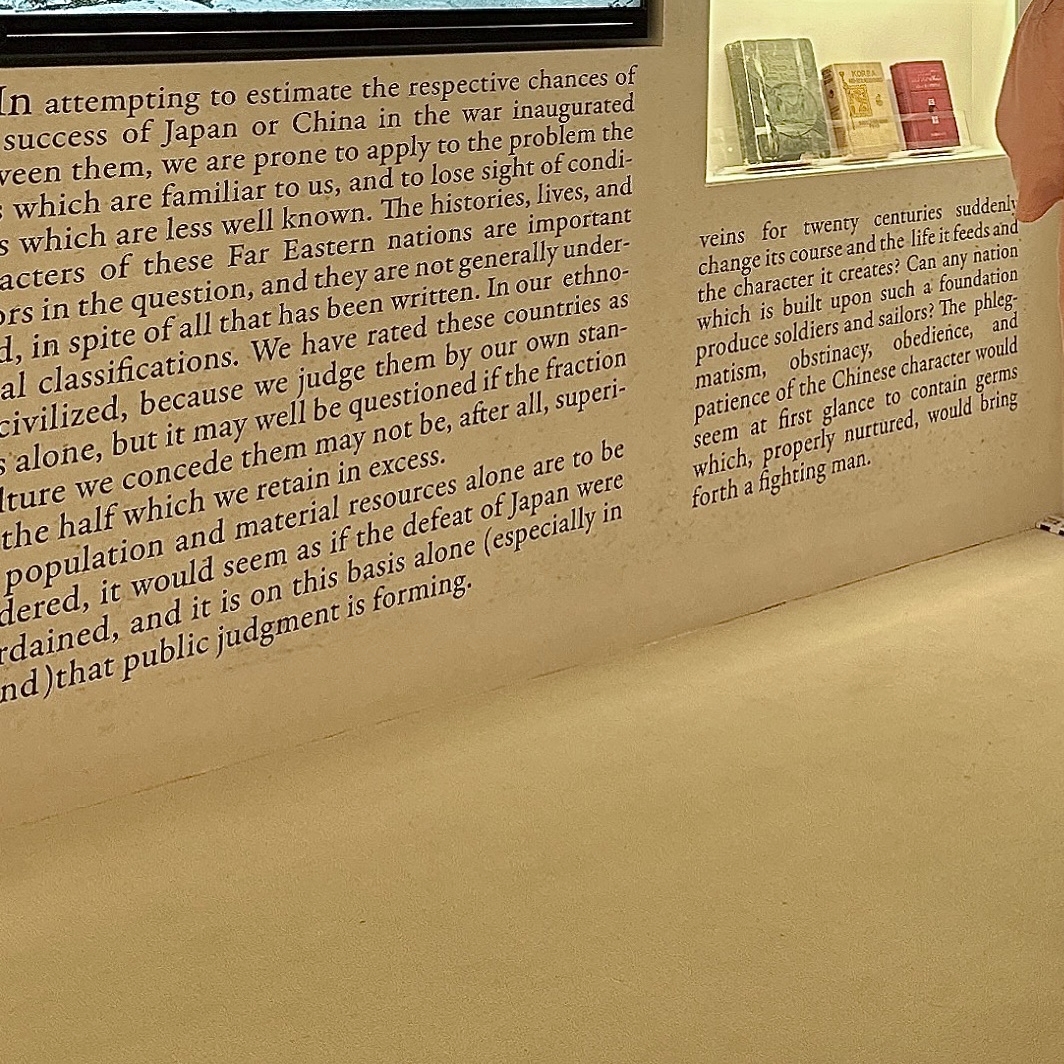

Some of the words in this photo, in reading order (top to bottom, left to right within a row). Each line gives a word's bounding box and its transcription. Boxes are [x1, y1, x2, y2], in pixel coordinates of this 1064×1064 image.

[45, 86, 201, 119] attempting
[210, 89, 236, 107] to
[246, 81, 352, 105] estimate
[361, 76, 400, 99] the
[408, 71, 520, 102] respective
[528, 68, 608, 90] chances
[615, 64, 639, 86] of
[697, 282, 727, 303] the
[733, 273, 815, 298] character
[820, 266, 833, 285] it
[838, 258, 900, 282] creates?
[906, 254, 937, 272] Can
[942, 252, 968, 271] any
[973, 243, 1019, 264] nation
[694, 362, 767, 390] matism,
[789, 343, 873, 371] obstinacy,
[893, 323, 974, 351] obedience,
[992, 310, 1019, 333] and
[1, 520, 49, 551] the
[57, 502, 119, 540] half
[122, 487, 206, 526] which
[212, 487, 249, 509] we
[255, 467, 330, 501] retain
[337, 460, 361, 485] in
[368, 449, 446, 478] excess.
